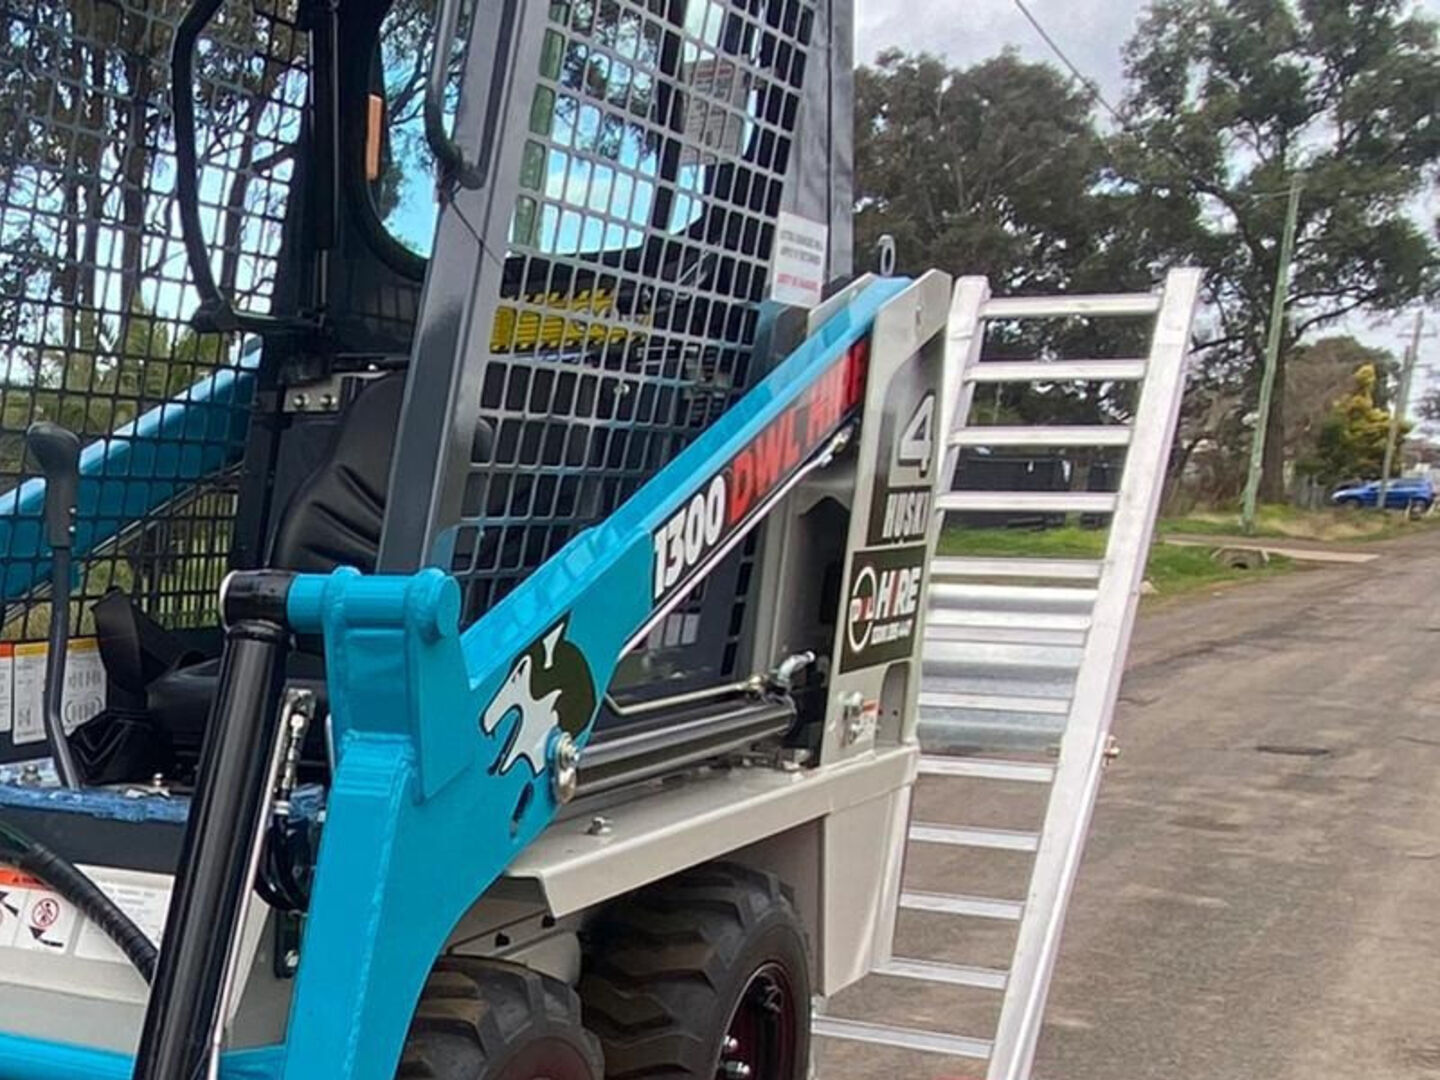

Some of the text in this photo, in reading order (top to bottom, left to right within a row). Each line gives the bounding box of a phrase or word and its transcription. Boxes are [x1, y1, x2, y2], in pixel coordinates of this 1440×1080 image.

[898, 391, 935, 475] 4
[654, 475, 726, 599] 1300
[730, 408, 801, 525] DWL
[875, 567, 921, 619] HIRE
